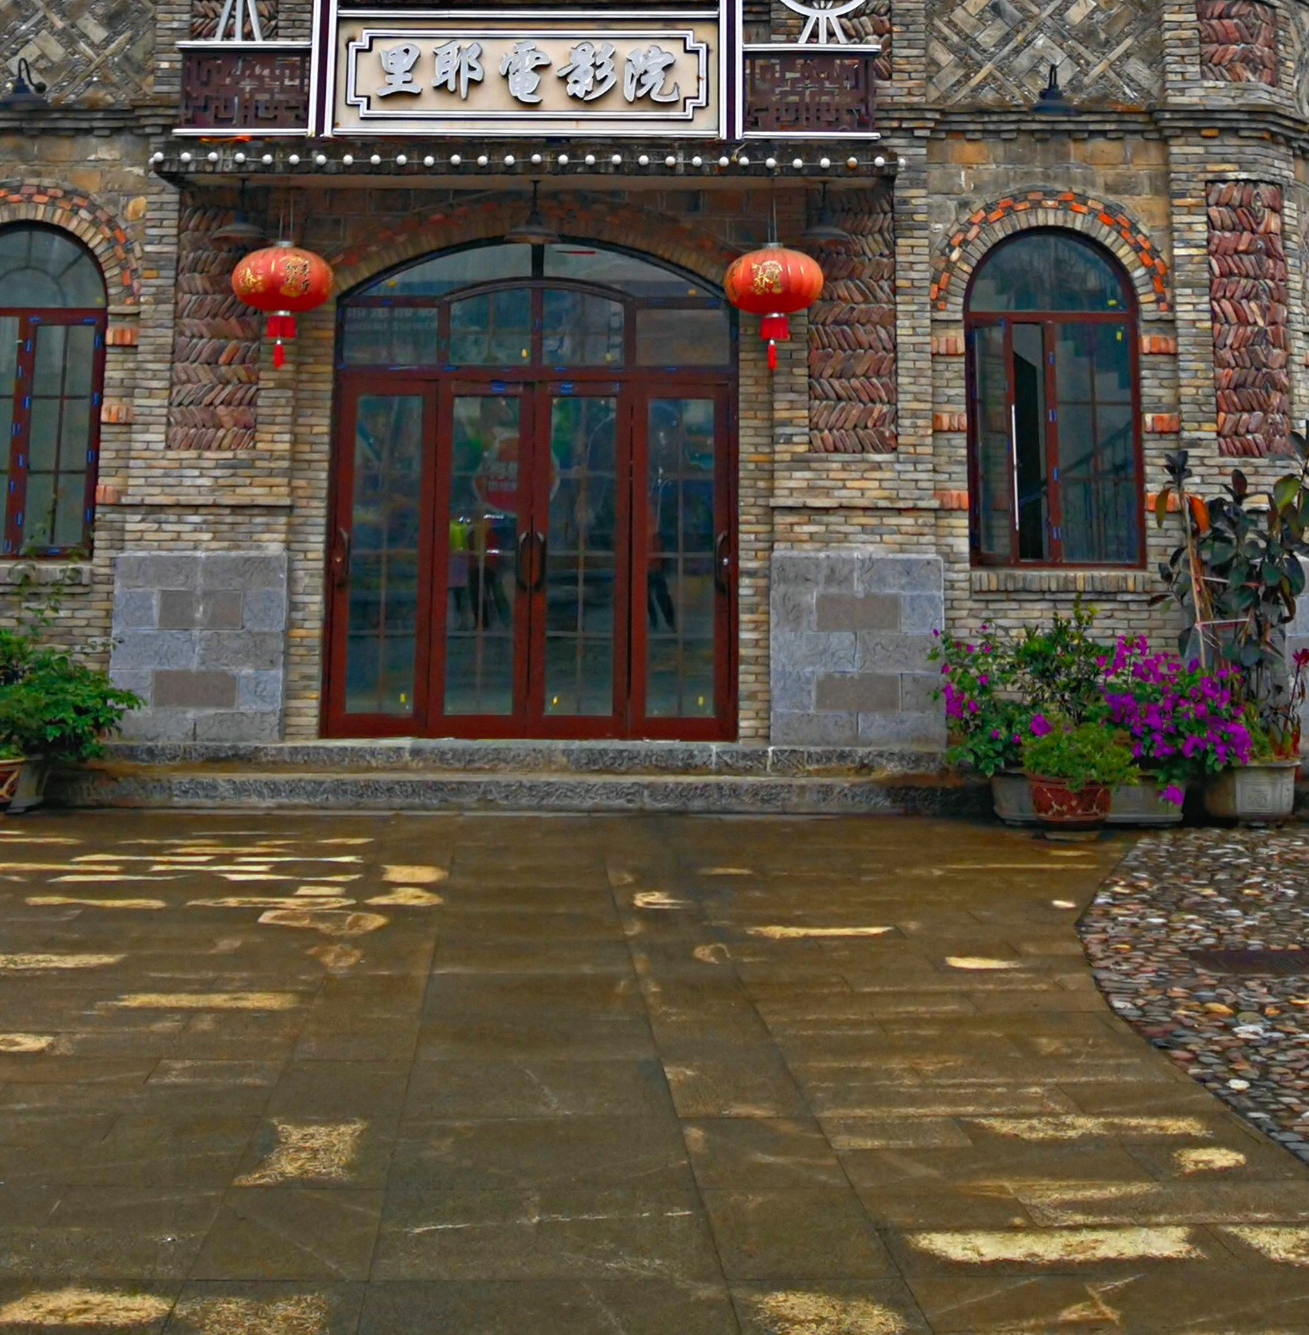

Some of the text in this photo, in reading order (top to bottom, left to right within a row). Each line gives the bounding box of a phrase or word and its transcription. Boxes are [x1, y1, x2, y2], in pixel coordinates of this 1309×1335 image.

[376, 39, 680, 104] 里耶電影院
